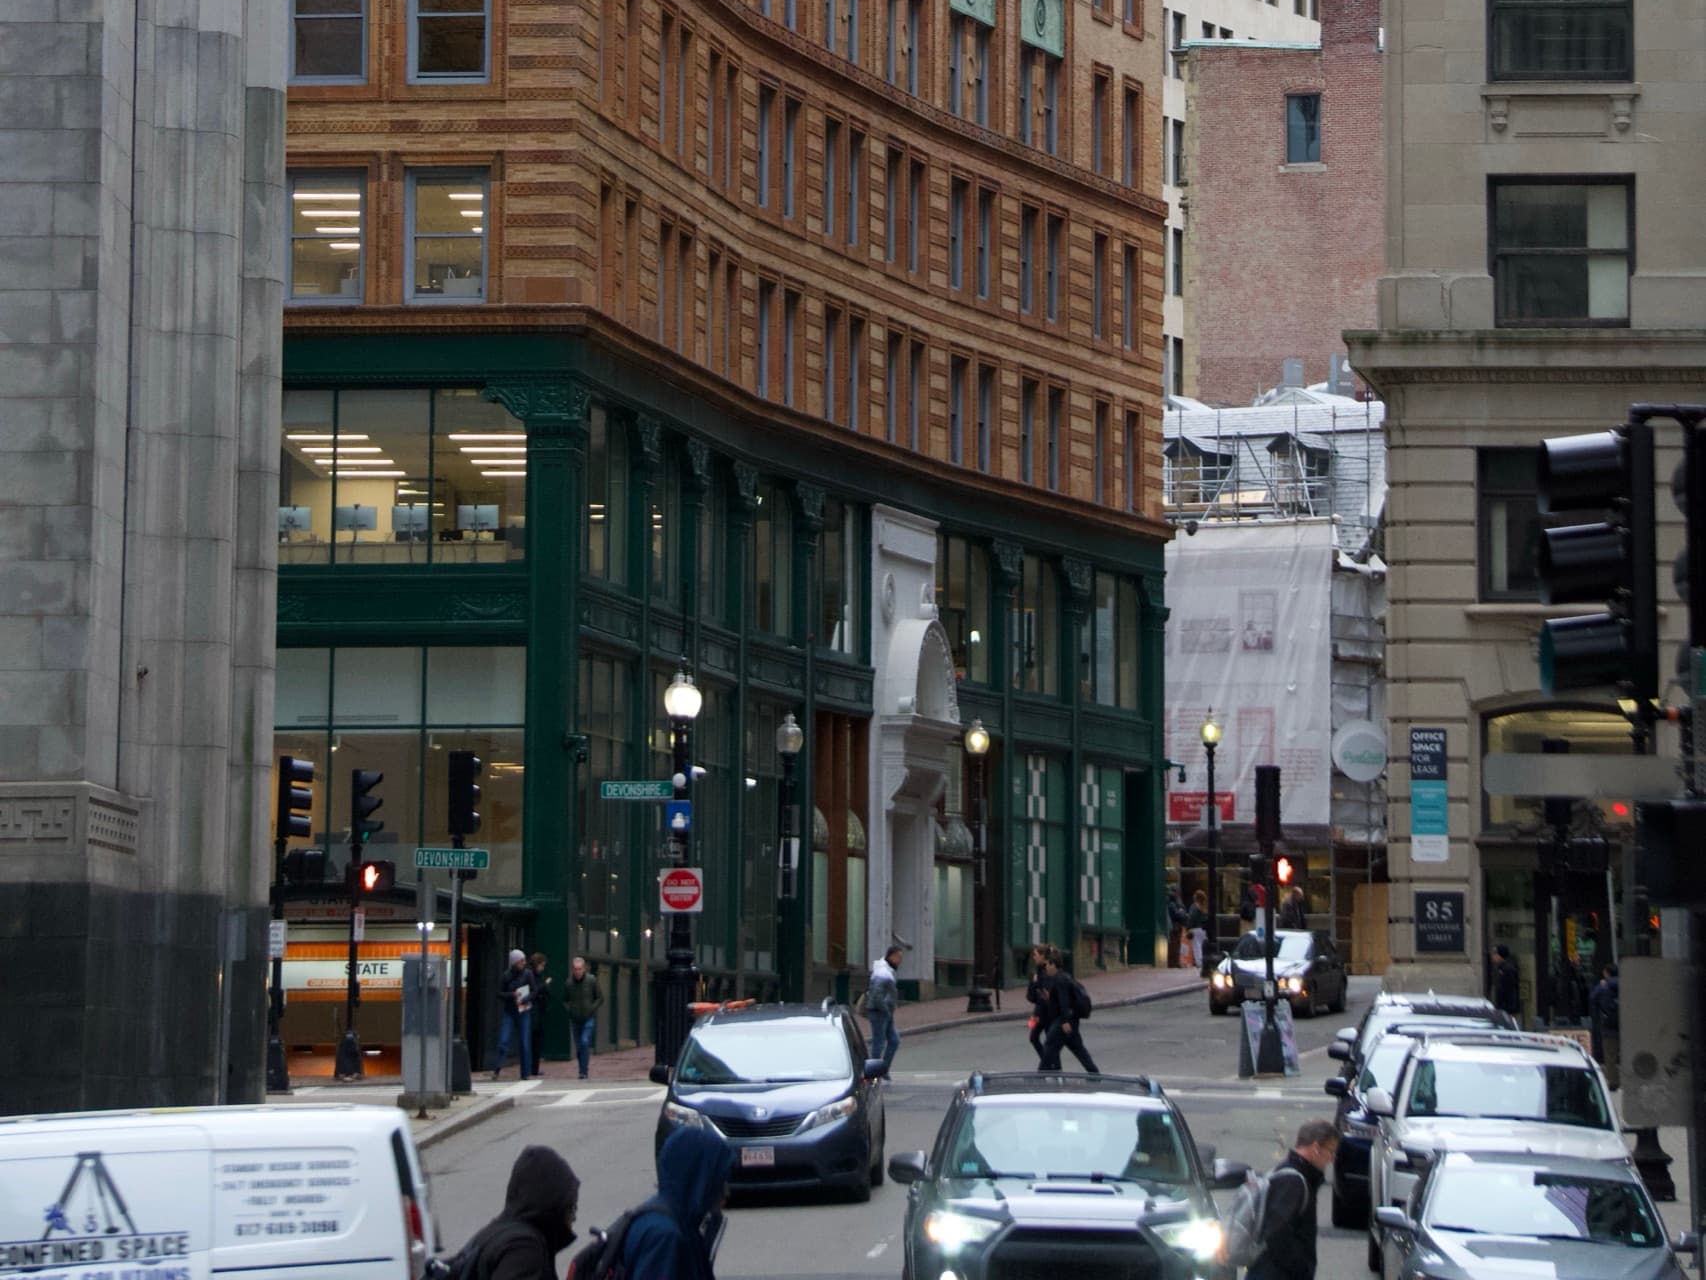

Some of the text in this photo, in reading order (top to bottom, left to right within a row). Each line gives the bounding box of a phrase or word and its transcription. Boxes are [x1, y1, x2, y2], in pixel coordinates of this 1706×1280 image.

[1412, 732, 1445, 741] OFFICE
[1412, 743, 1442, 752] SPACE
[1412, 754, 1431, 762] FOR
[1412, 765, 1439, 774] LEASE
[605, 783, 662, 796] DEVONSHIRE
[417, 851, 475, 867] DEVONSHIRE
[669, 895, 693, 903] ENTER
[1426, 901, 1453, 920] 85
[344, 963, 388, 975] STATE
[117, 1235, 190, 1260] SPACE
